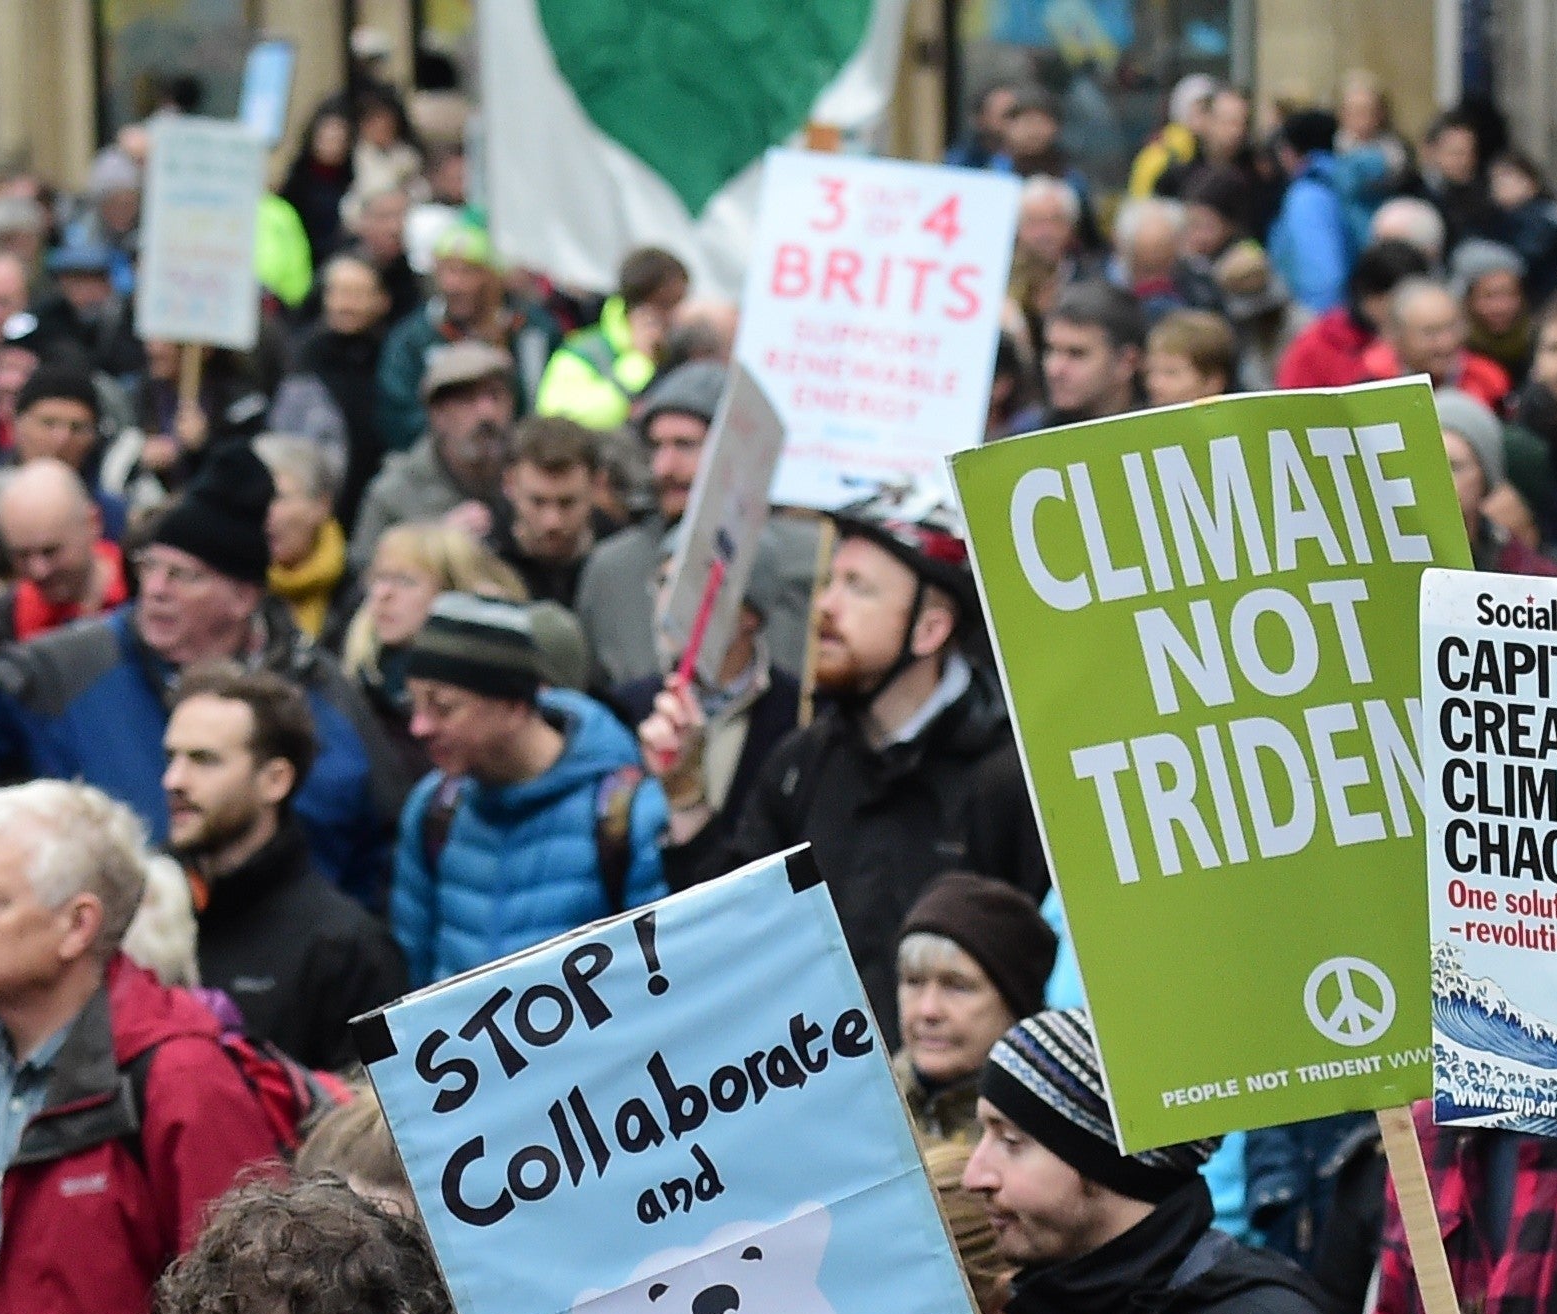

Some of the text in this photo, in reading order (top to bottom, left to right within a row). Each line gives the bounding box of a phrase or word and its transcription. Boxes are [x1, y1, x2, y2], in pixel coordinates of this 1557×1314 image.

[809, 176, 848, 233] 3
[920, 193, 962, 249] 4
[770, 243, 983, 322] BRITS
[763, 347, 959, 396] RENEWABLE
[793, 319, 942, 358] SUPPORT
[792, 384, 920, 422] ENERGY
[1009, 421, 1435, 612] CLIMATE
[1133, 577, 1374, 716] NOT
[1070, 698, 1427, 886] TRIDEN
[1447, 879, 1498, 911] One
[441, 1005, 874, 1228] Collaborate
[1160, 1078, 1240, 1110] PEOPLE
[1245, 1074, 1290, 1094] NOT
[1295, 1055, 1383, 1084] TRIDENT
[636, 1144, 725, 1227] and
